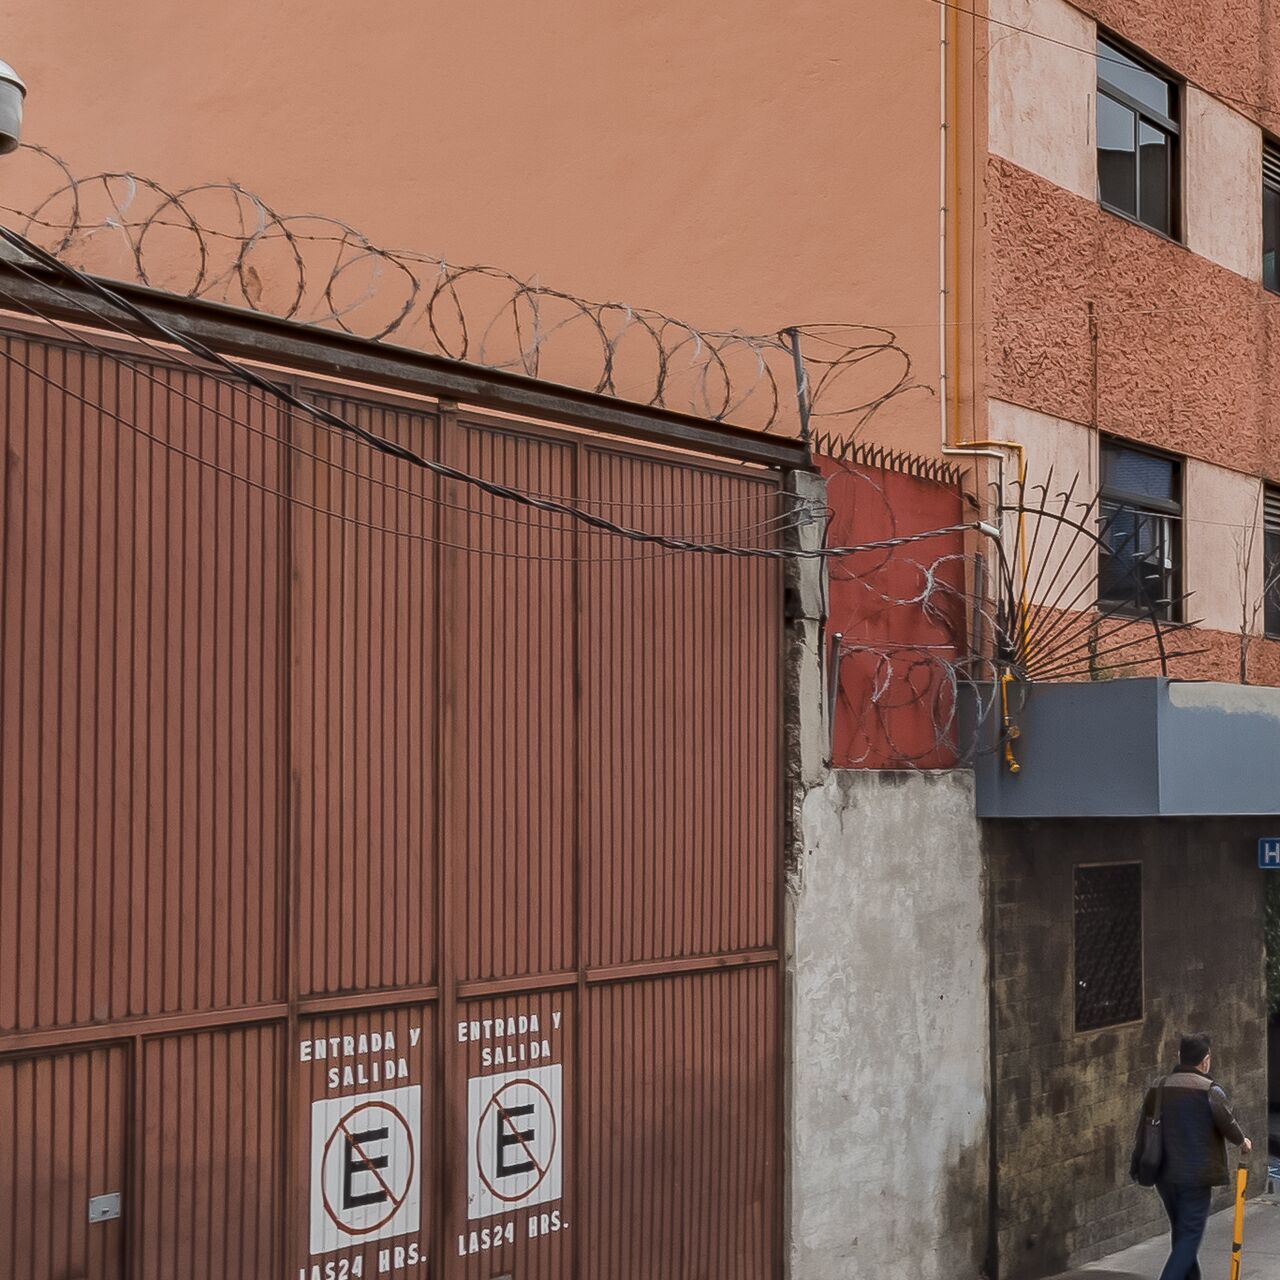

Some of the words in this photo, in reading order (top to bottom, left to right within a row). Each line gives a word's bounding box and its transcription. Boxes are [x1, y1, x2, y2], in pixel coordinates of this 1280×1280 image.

[1264, 842, 1280, 864] H
[458, 1014, 540, 1042] ENTRADA
[552, 1011, 562, 1030] Y
[299, 1030, 396, 1062] ENTRADA
[481, 1039, 551, 1067] SALIDA
[327, 1058, 409, 1089] SALIDA
[495, 1103, 536, 1179] E
[342, 1126, 390, 1210] E
[527, 1210, 570, 1239] HRS.
[378, 1242, 428, 1273] HRS.
